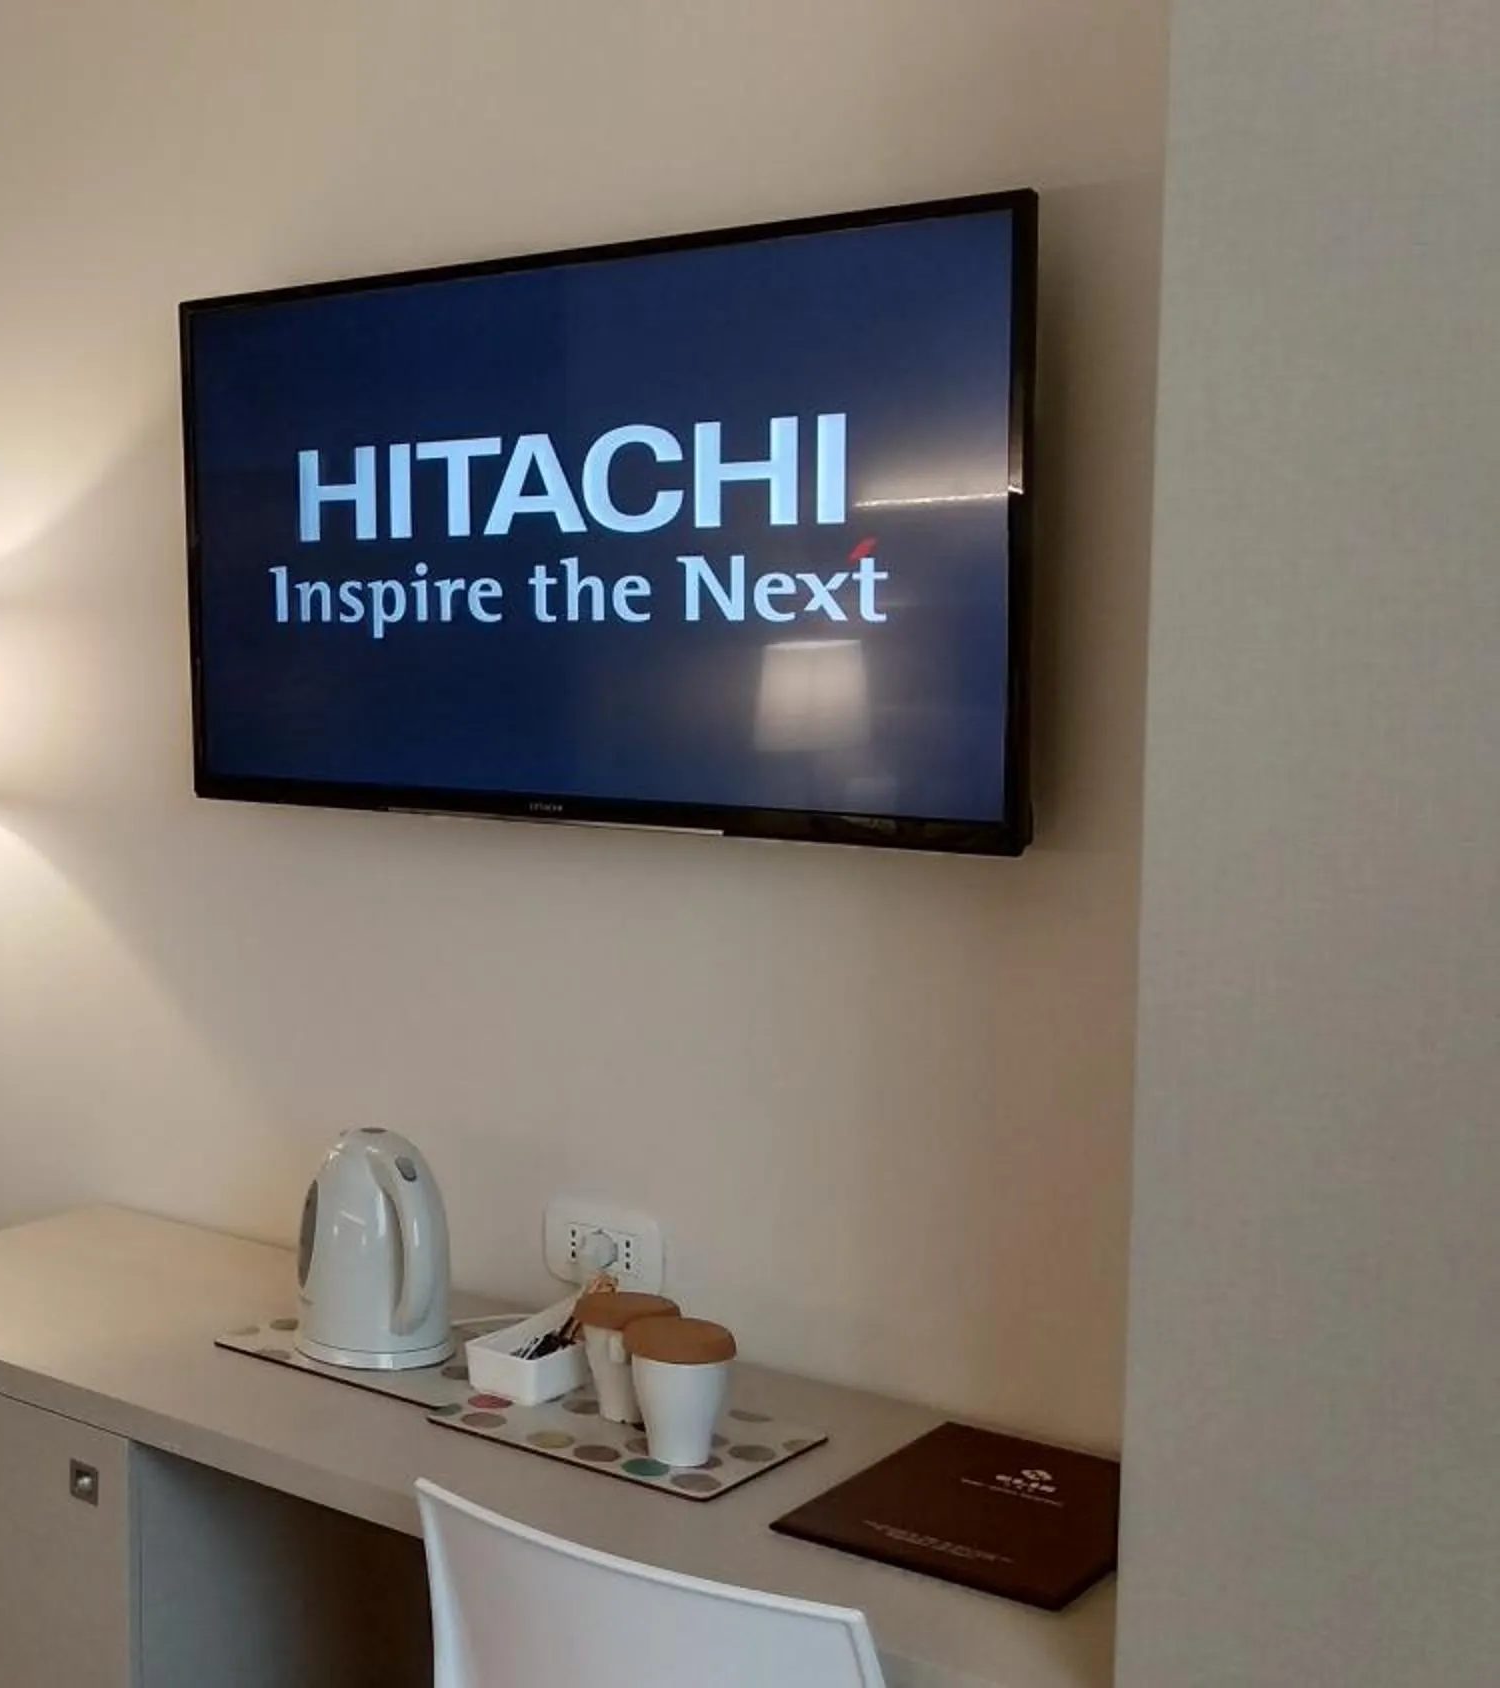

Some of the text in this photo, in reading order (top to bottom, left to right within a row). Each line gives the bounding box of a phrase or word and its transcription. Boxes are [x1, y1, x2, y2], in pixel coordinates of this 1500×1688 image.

[298, 412, 847, 543] HITACHI
[268, 546, 889, 639] Inspire the Next
